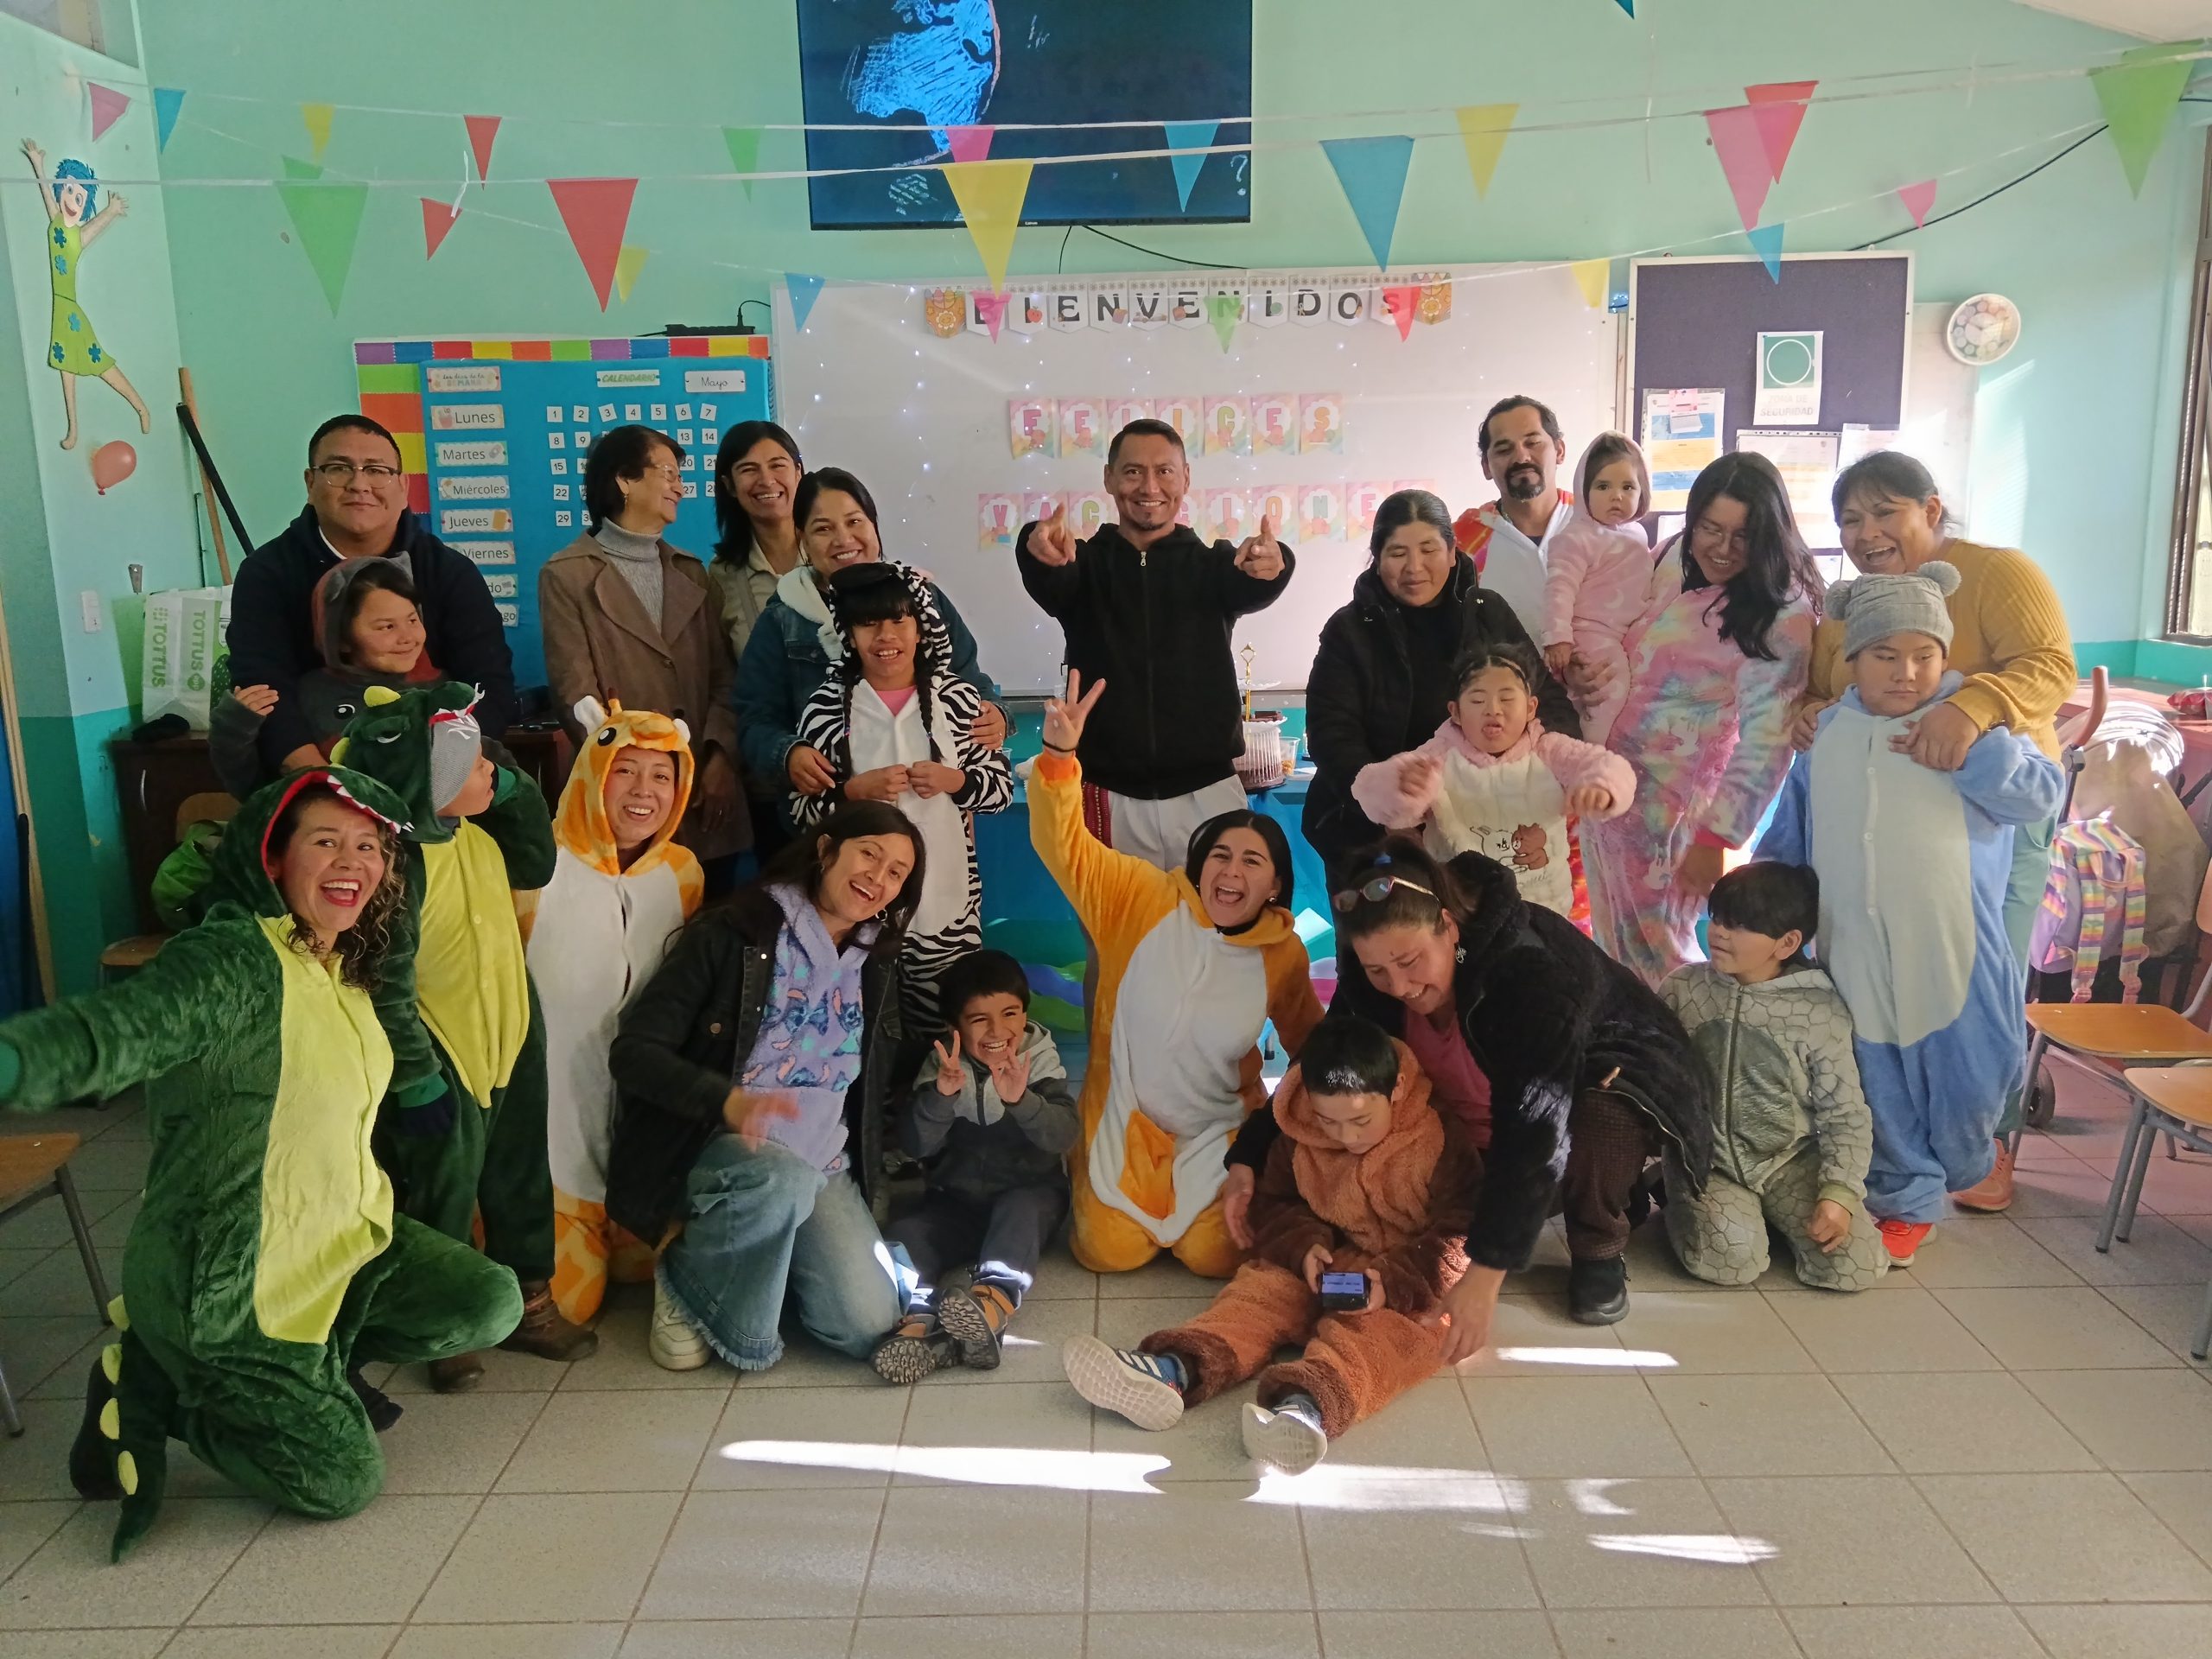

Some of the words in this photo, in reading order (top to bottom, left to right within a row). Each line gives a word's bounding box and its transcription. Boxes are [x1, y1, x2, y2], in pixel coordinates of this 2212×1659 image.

[974, 289, 1401, 325] BIENVENIDOS
[601, 373, 656, 383] CALENDARIO
[701, 377, 728, 390] Mayo
[578, 410, 584, 418] 2
[604, 409, 611, 417] 3
[630, 408, 636, 416] 4
[655, 407, 662, 416] 5
[680, 407, 687, 416] 6
[705, 408, 712, 416] 7
[1760, 407, 1814, 416] SEGURIDAD
[454, 412, 495, 424] Lunes
[554, 436, 560, 445] 8
[580, 435, 586, 444] 9
[680, 432, 690, 442] 13
[442, 448, 486, 461] Martes
[553, 462, 564, 471] 15
[453, 484, 506, 495] Miércoles
[555, 488, 568, 497] 22
[683, 486, 695, 494] 27
[448, 516, 489, 530] Jueves
[557, 514, 569, 523] 29
[463, 548, 509, 559] Viernes
[191, 610, 206, 671] TOTTUS
[151, 622, 168, 688] TOTTUS
